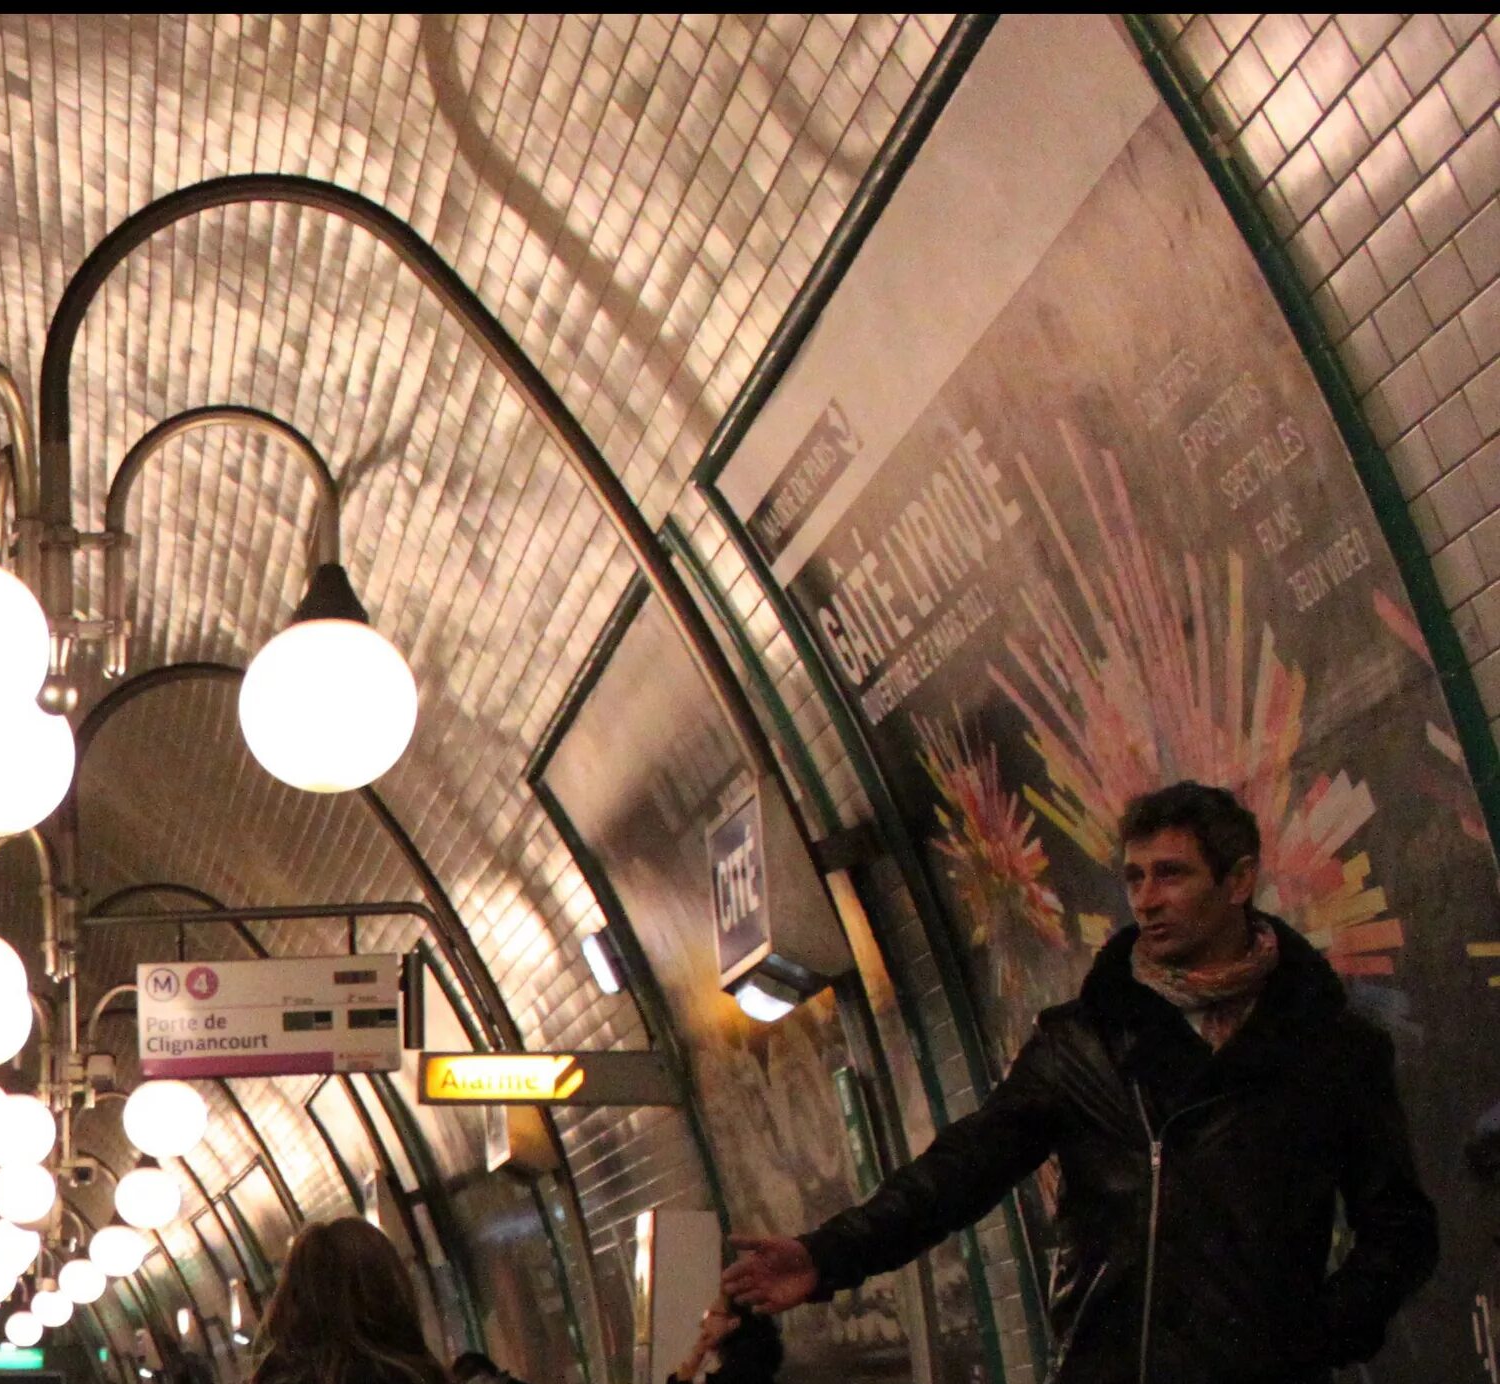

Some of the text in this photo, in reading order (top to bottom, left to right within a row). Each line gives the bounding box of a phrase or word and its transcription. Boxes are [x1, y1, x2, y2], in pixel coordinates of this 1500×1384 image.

[882, 427, 1023, 618] LYRIQUE
[718, 824, 760, 933] CITÉ
[146, 1013, 227, 1032] Porte de
[146, 1034, 269, 1054] Clignancourt
